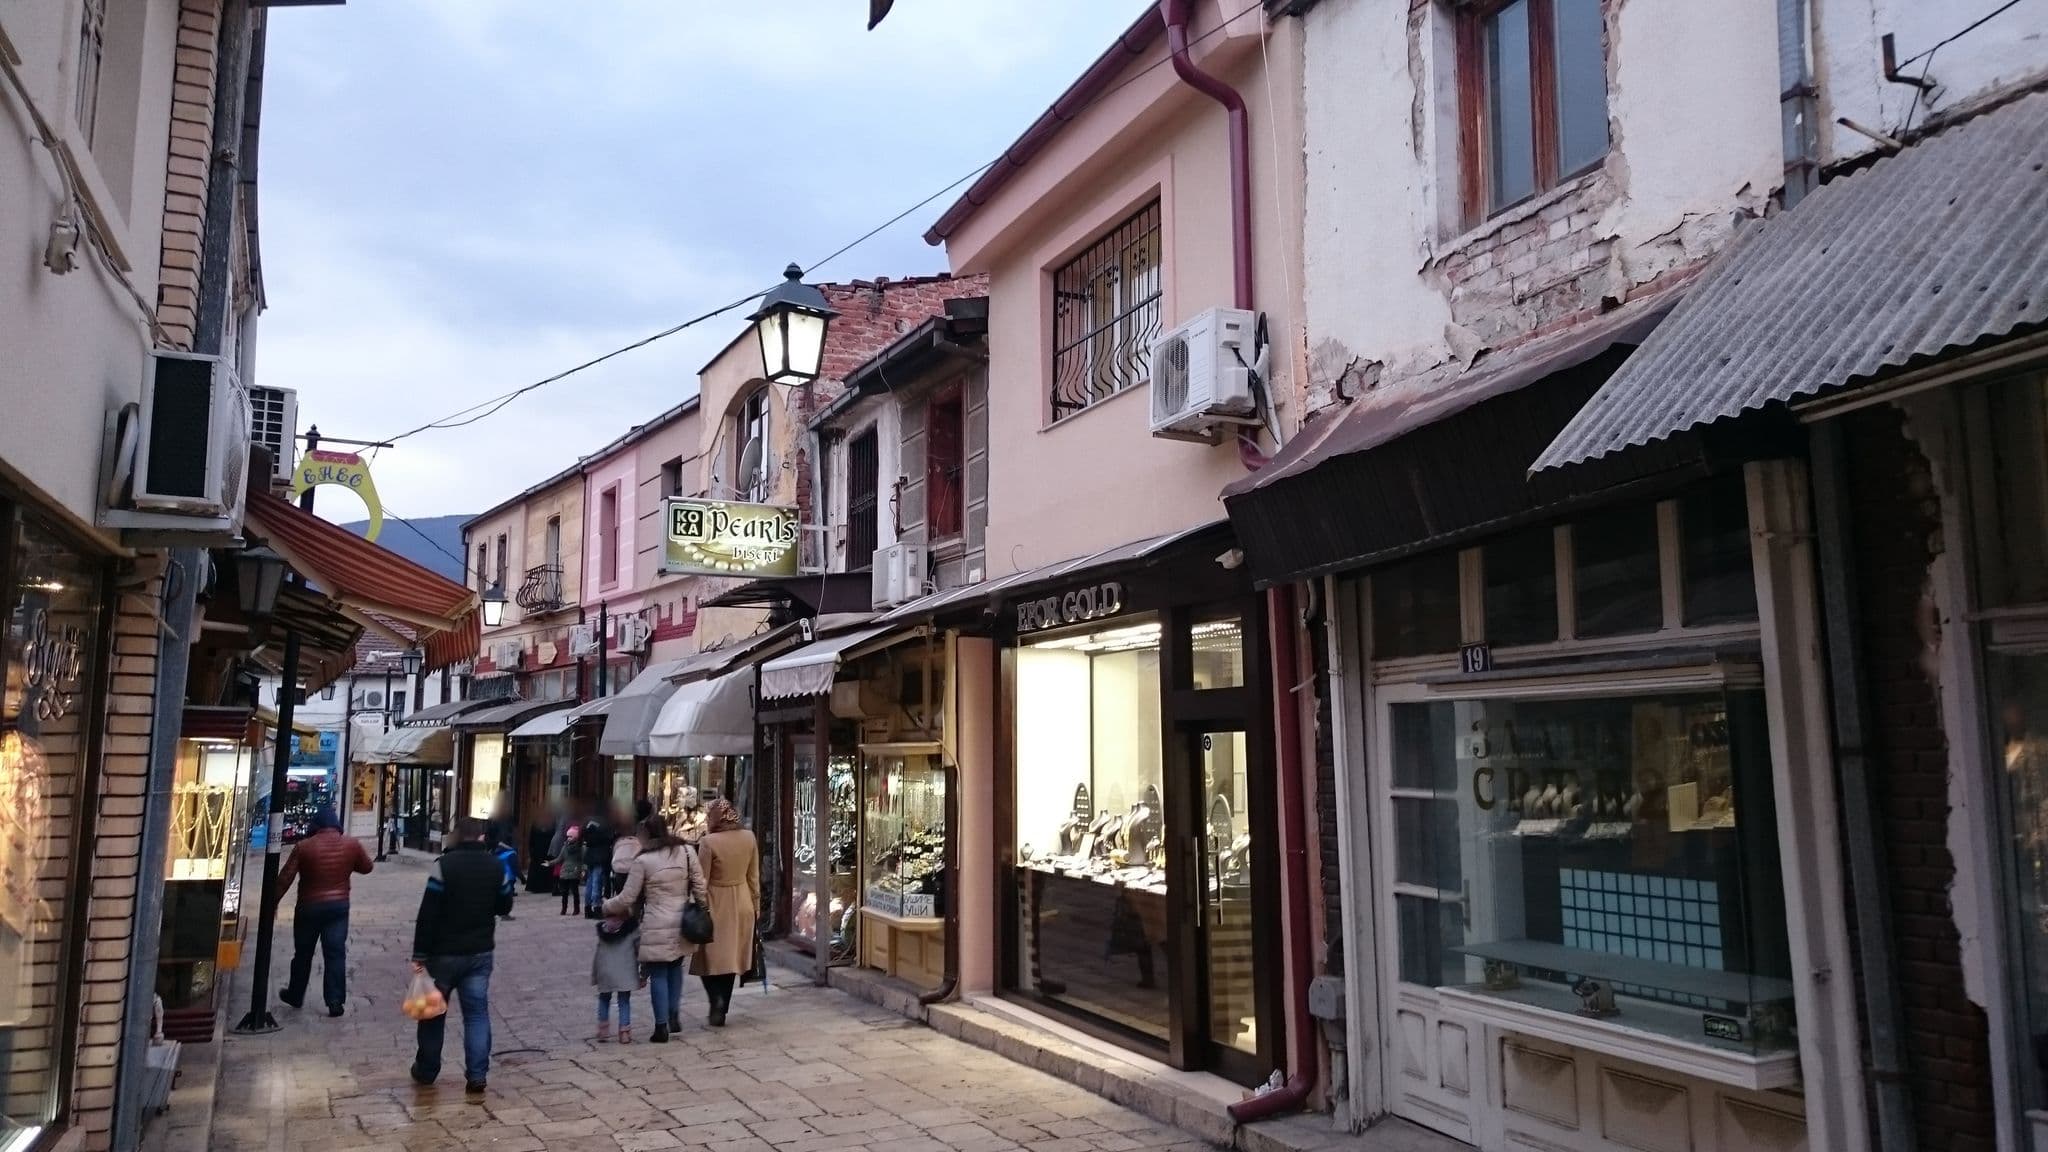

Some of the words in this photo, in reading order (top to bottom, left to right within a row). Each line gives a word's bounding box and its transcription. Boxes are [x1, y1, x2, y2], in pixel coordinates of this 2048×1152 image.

[711, 510, 795, 543] Pearls
[1062, 582, 1121, 622] GOLD
[1466, 647, 1483, 673] 19
